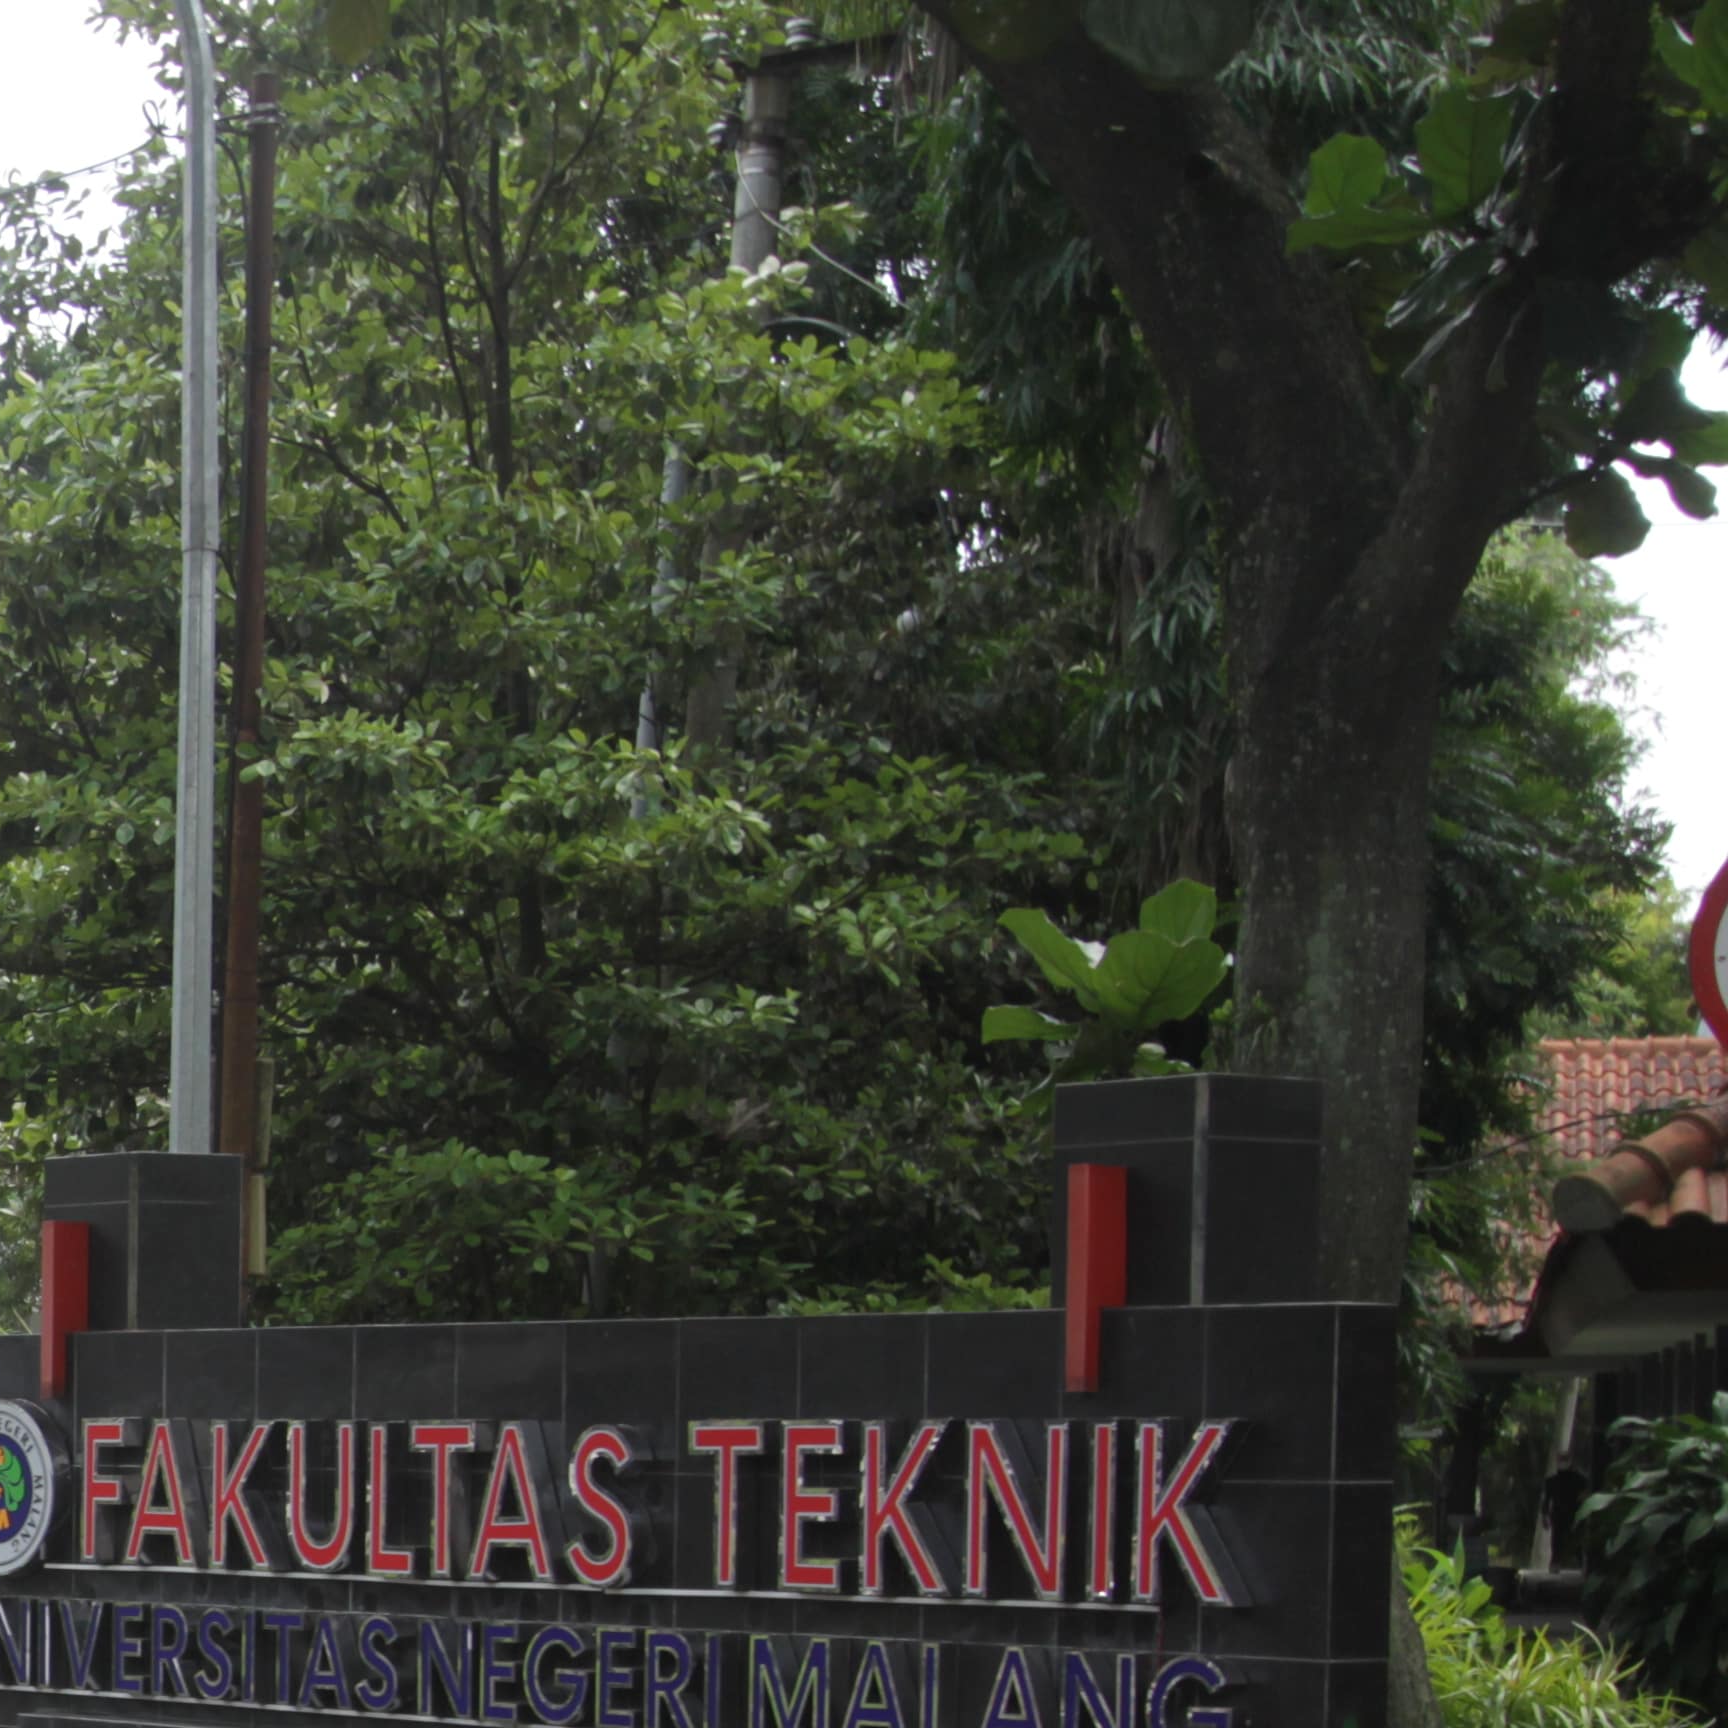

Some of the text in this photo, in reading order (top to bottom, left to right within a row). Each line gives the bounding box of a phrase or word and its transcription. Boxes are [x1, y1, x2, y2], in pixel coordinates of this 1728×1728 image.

[10, 1474, 45, 1553] MALANG
[79, 1417, 1236, 1605] FAKULTAS TEKNIK
